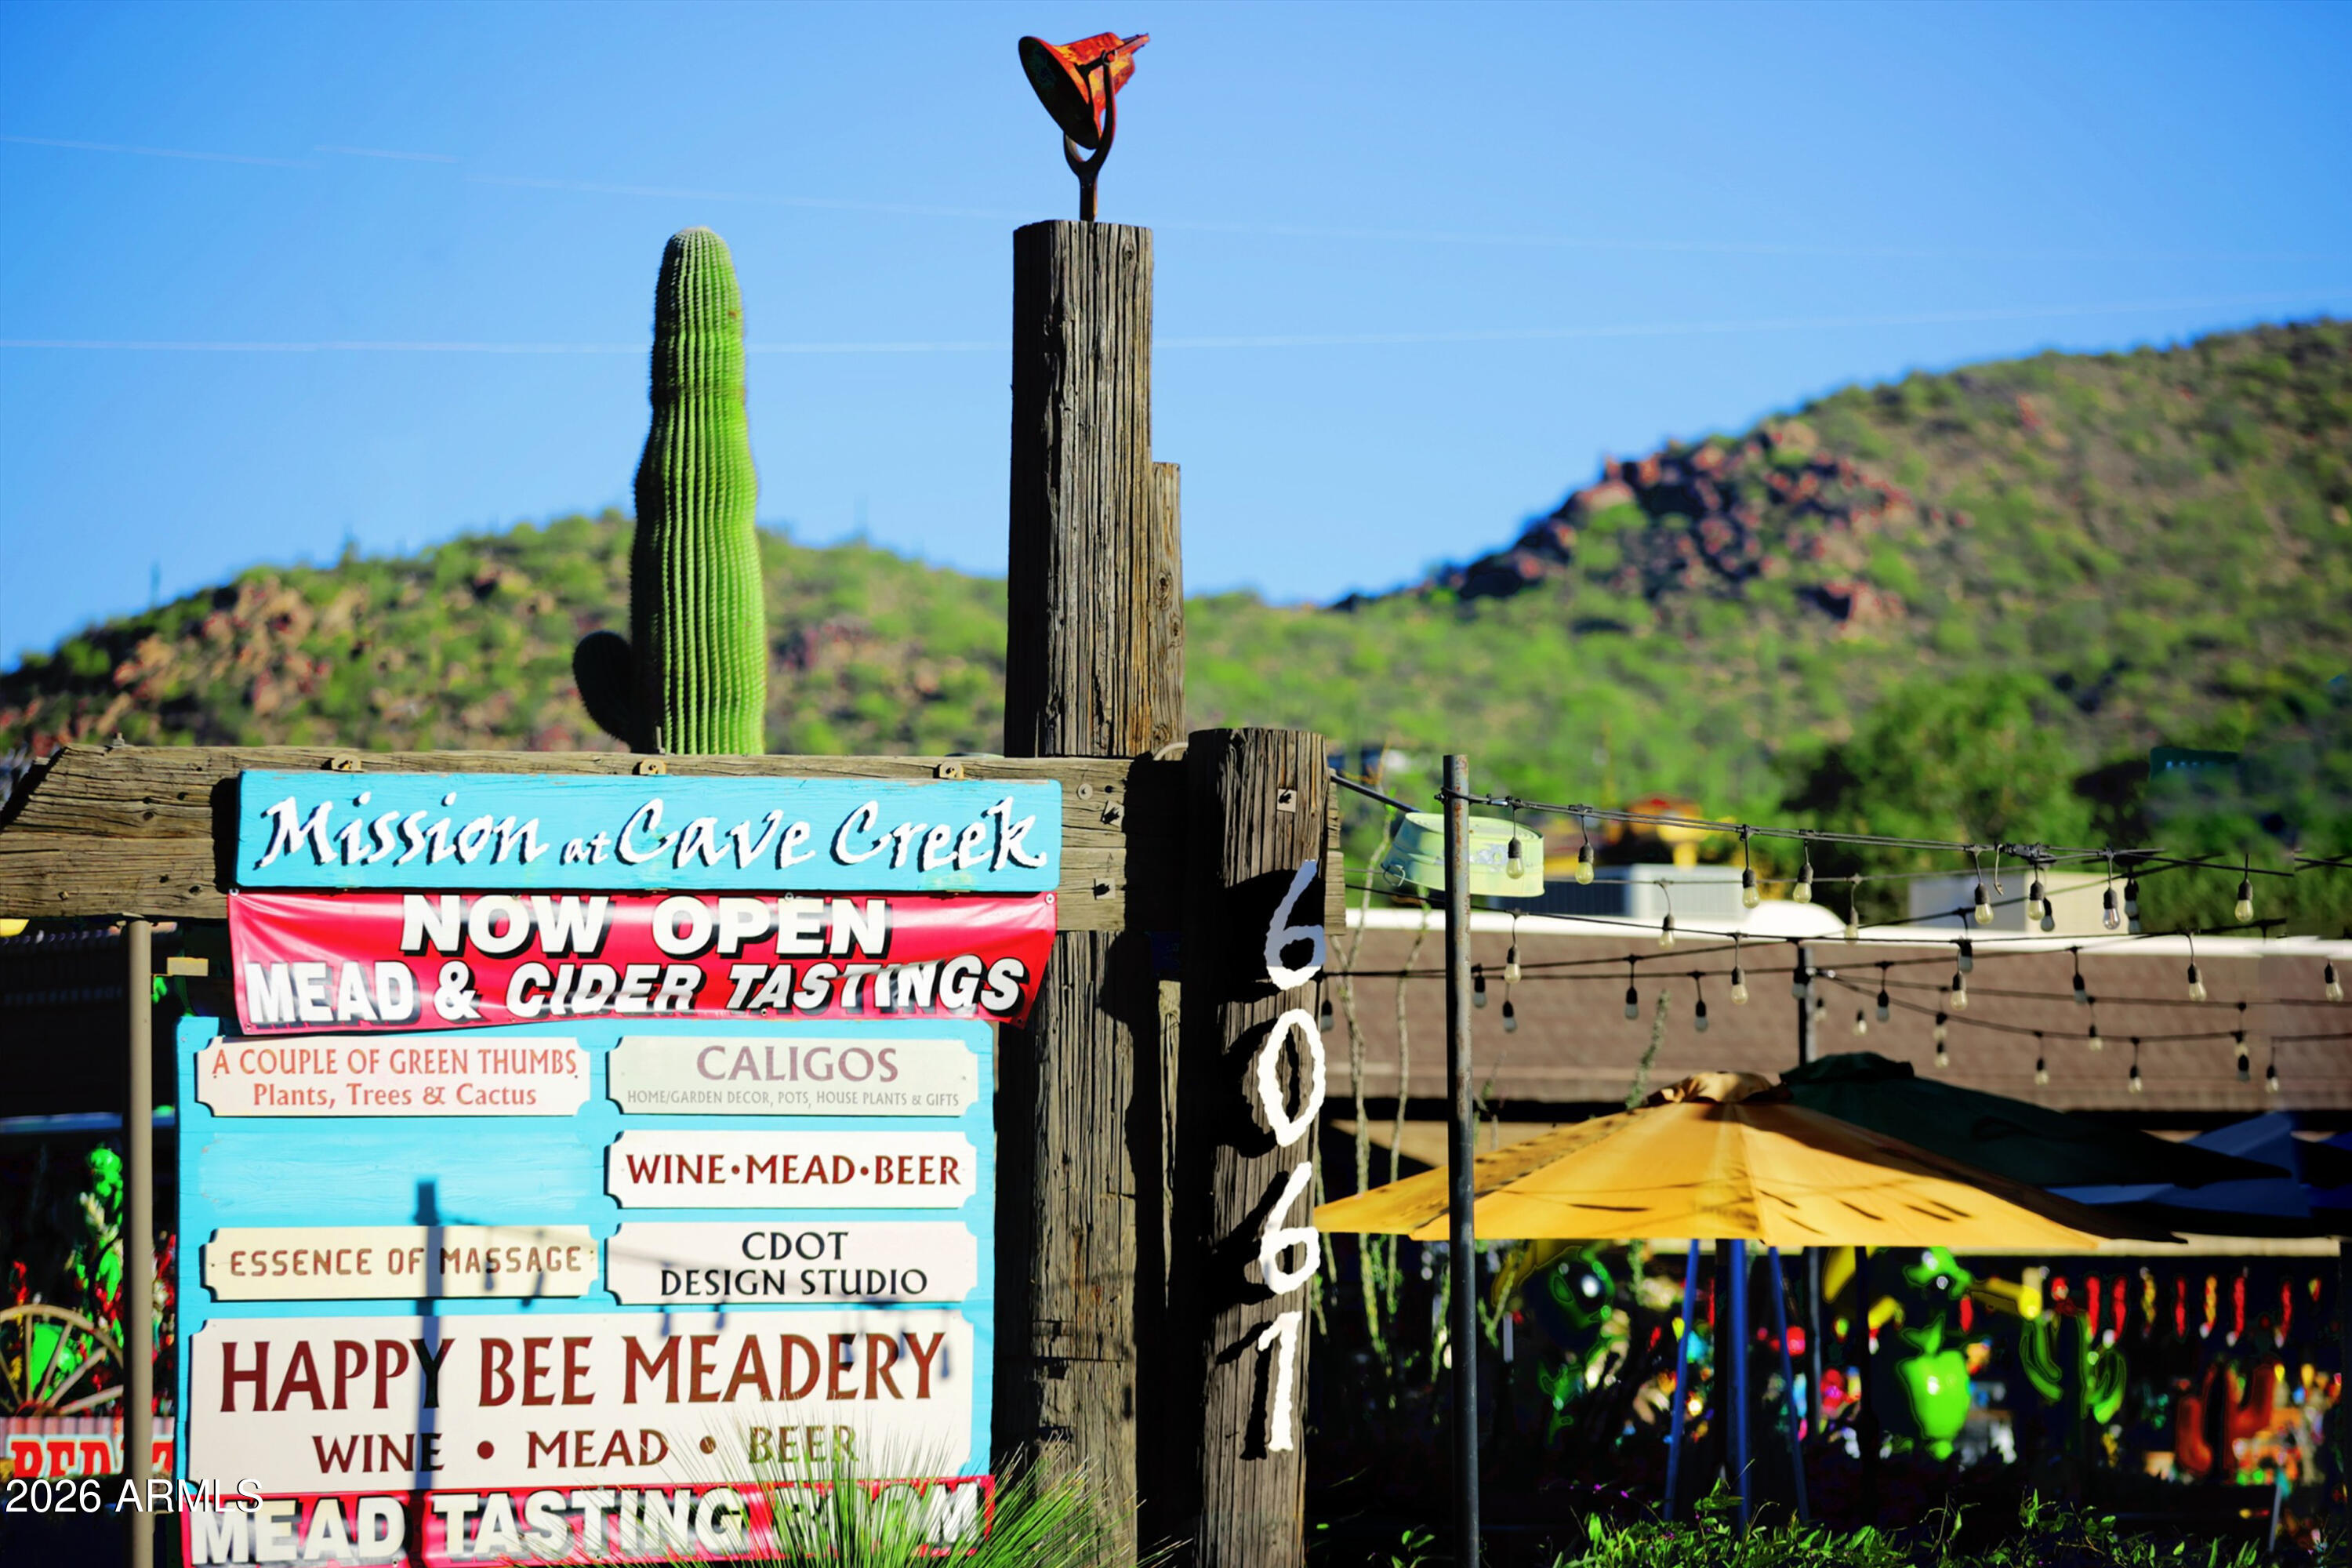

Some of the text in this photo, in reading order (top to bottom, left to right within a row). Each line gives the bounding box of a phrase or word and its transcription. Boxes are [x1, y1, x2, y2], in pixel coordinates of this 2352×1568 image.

[254, 791, 1047, 871] Mission at Cave Creek
[400, 894, 887, 955] NOW OPEN
[244, 954, 1025, 1024] MEAD & CIDER TASTINGS
[212, 1048, 577, 1075] A COUPLE OF GREEN THUMBS
[696, 1045, 898, 1083] CALIGOS
[252, 1083, 537, 1109] Plants, Trees & Cactus
[627, 1090, 960, 1109] HOME/GARDEN DECOR, POTS, HOUSE PLANTS & GIFTS
[1258, 860, 1326, 1452] 6061
[230, 1245, 583, 1277] ESSENCE OF MASSAGE
[742, 1231, 850, 1261] CDOT
[660, 1269, 928, 1296] DESIGN STUDIO
[220, 1332, 946, 1413] HAPPY BEE MEADERY
[312, 1424, 860, 1474] WINE MEAD BEER
[189, 1495, 405, 1565] MEAD
[432, 1487, 751, 1561] TASTING
